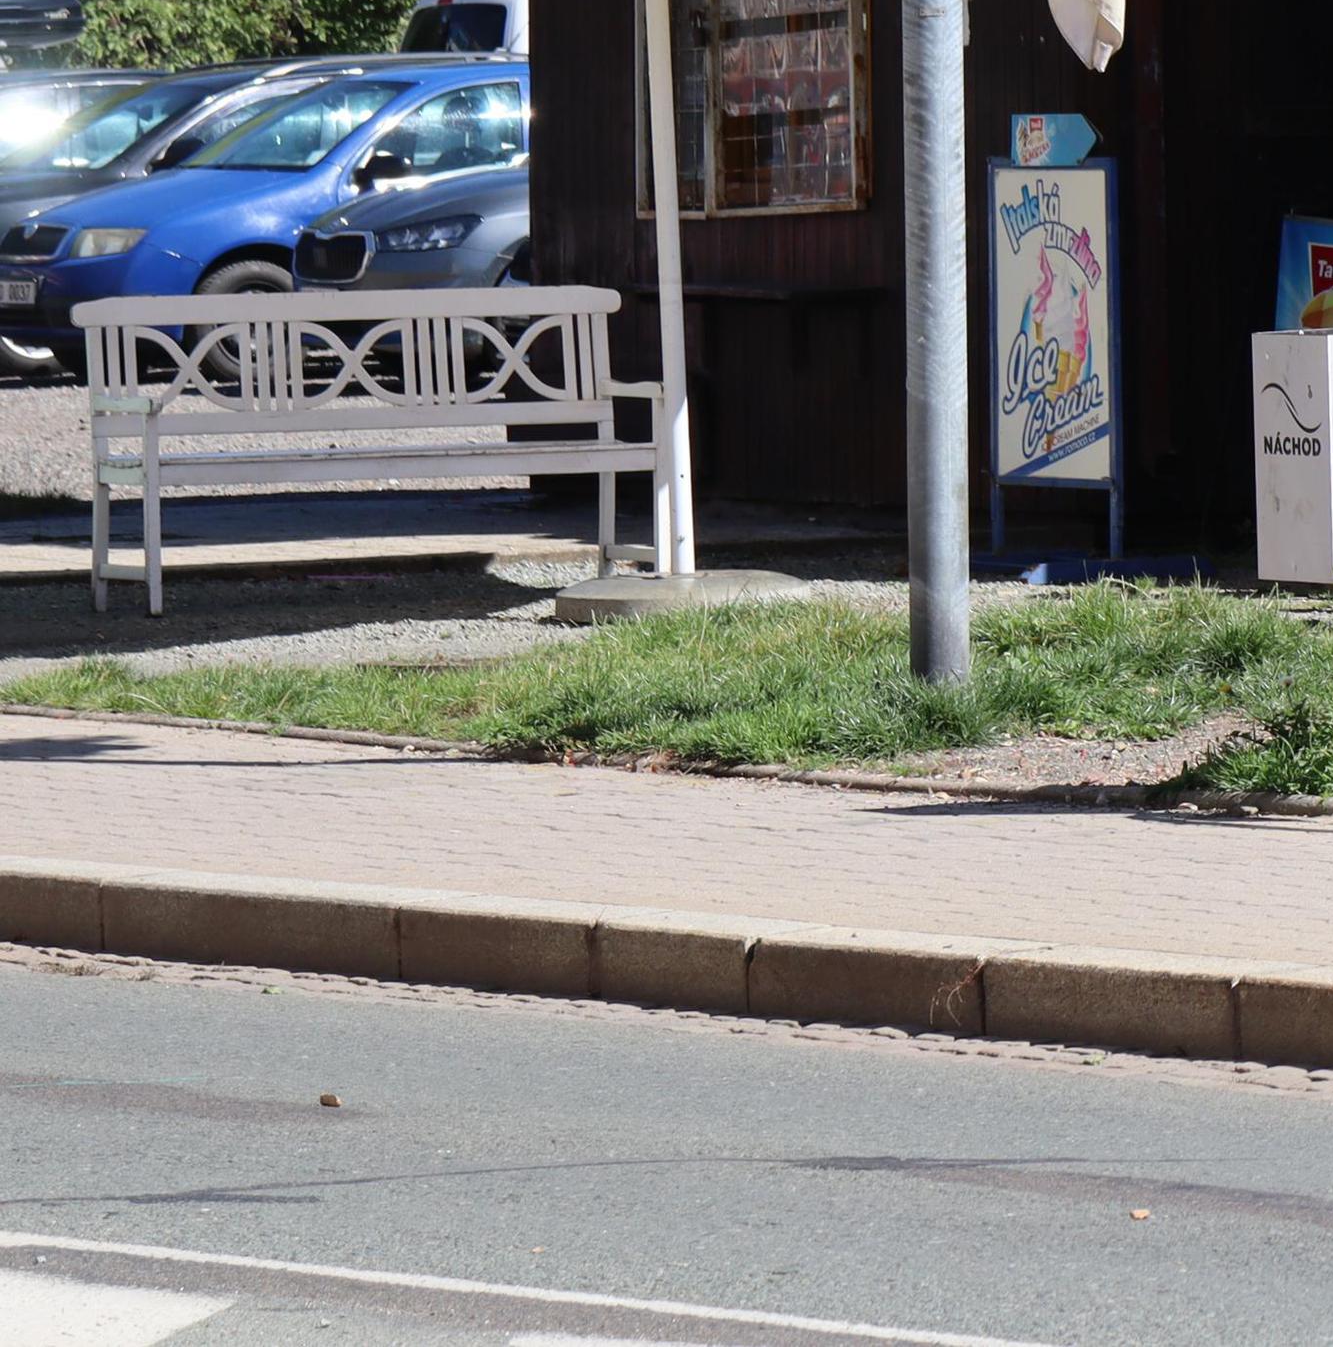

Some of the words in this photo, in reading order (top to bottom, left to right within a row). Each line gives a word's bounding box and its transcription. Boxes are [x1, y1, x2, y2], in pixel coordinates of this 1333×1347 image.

[1000, 179, 1060, 255] Italská
[1044, 222, 1102, 290] zmrzlina
[1002, 330, 1060, 415] Ice
[1022, 373, 1104, 459] Cream
[1263, 431, 1321, 457] NÁCHOD
